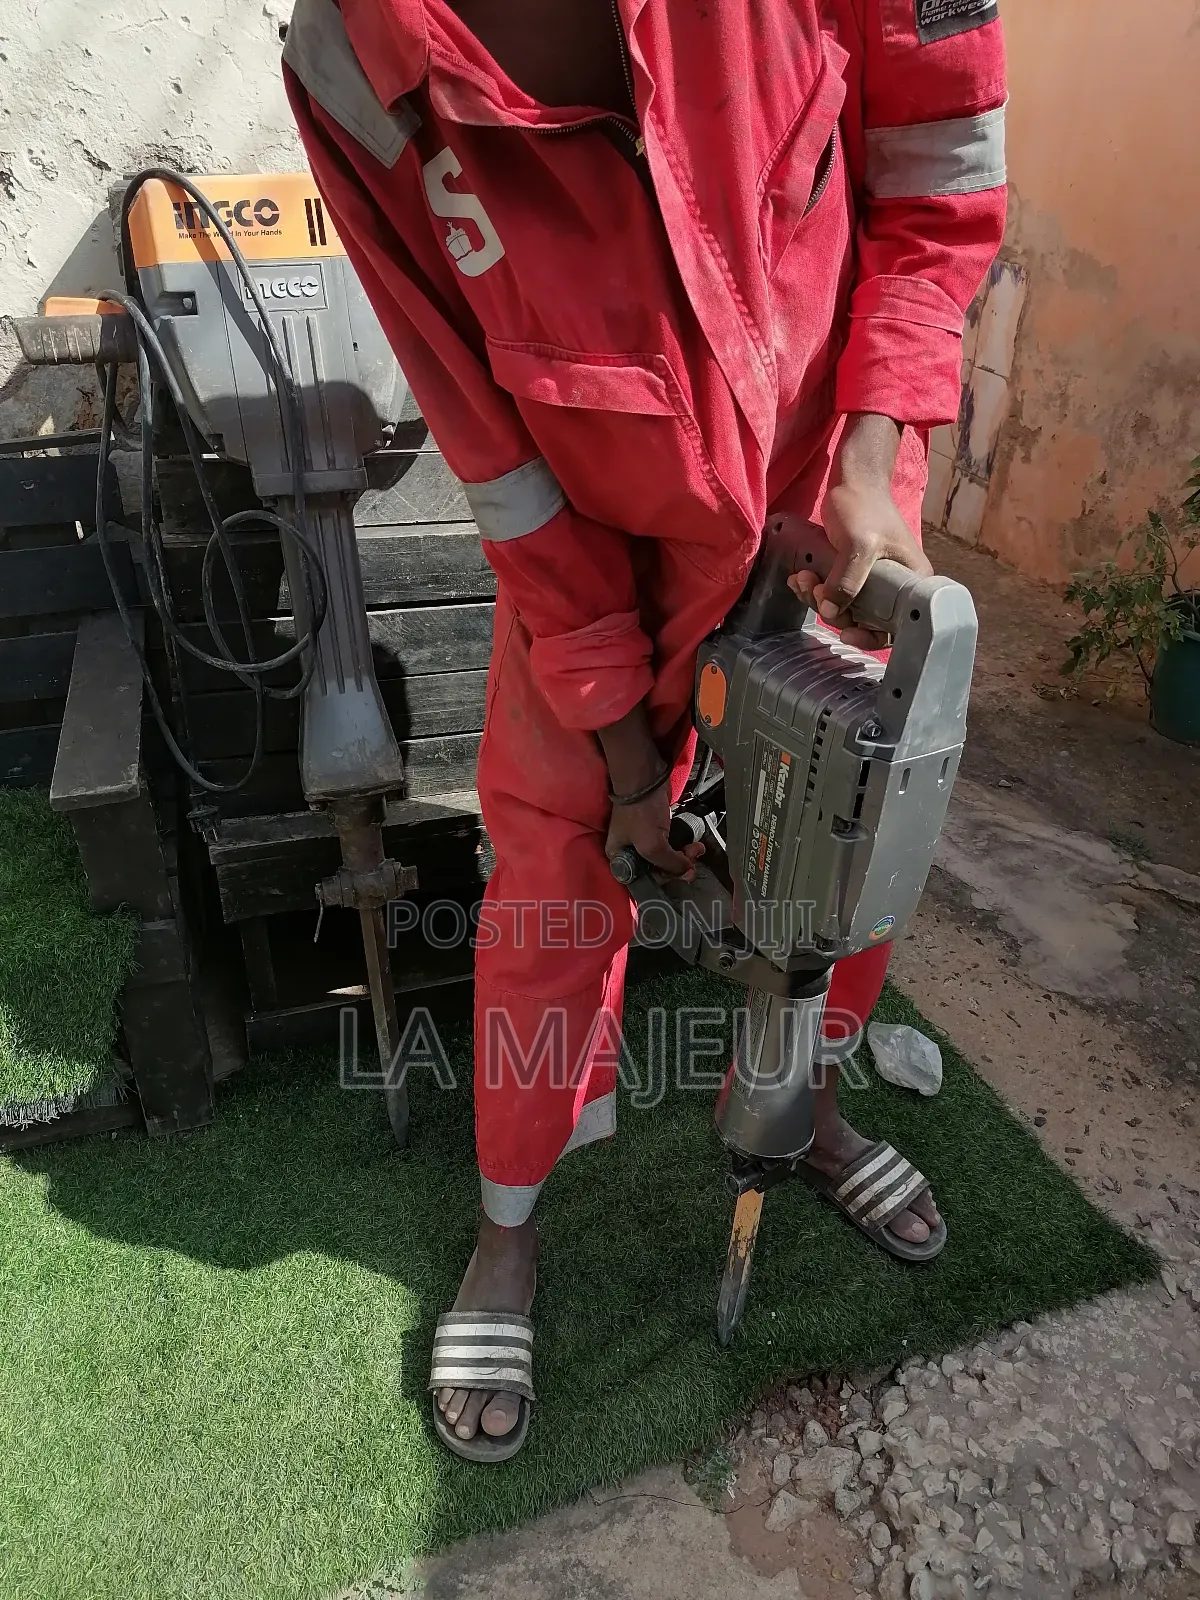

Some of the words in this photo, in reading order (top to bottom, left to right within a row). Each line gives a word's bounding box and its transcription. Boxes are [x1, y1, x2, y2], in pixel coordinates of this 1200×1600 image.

[775, 761, 790, 809] Kzubr
[765, 813, 778, 863] DEMOLITION
[760, 862, 771, 898] HAMMER
